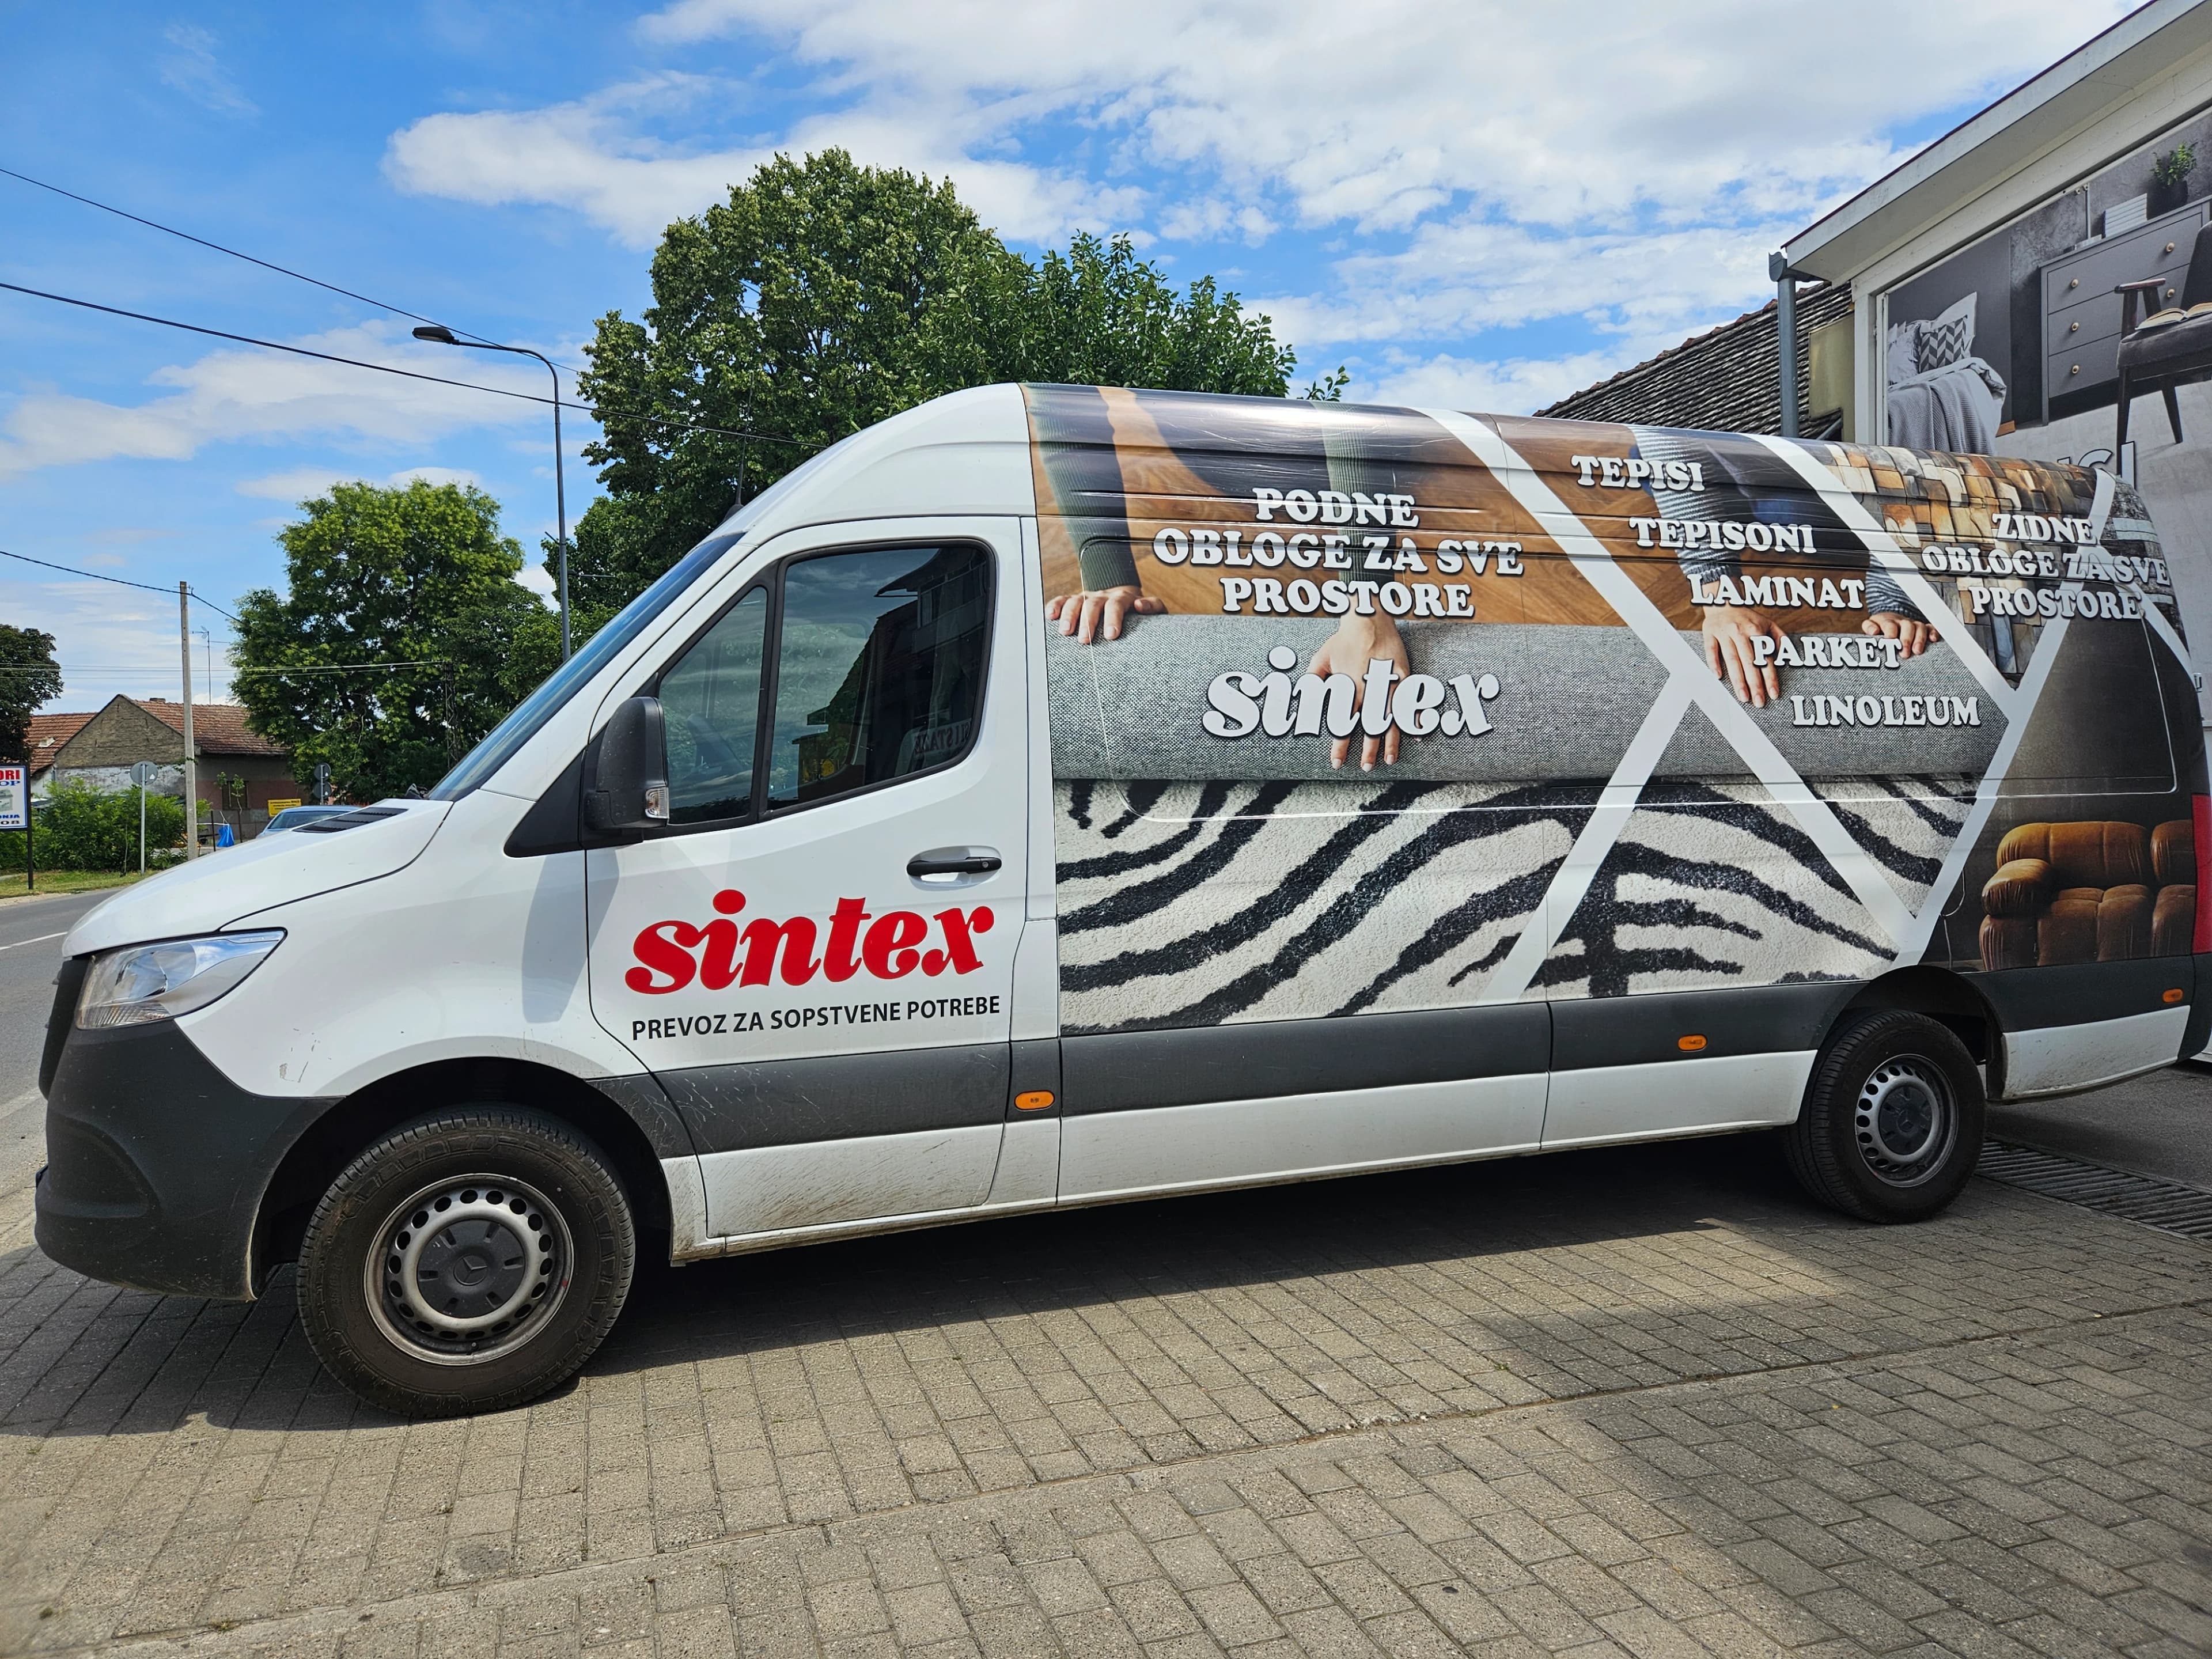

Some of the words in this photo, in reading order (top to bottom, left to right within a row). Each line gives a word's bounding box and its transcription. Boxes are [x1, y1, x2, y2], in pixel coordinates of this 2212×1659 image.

[1571, 455, 1705, 492] TEPISI
[1252, 487, 1419, 528] PODNE
[1629, 517, 1817, 554] TEPISONI
[1992, 513, 2098, 546] ZIDNE
[1153, 527, 1353, 570] OBLOGE
[1362, 535, 1427, 572] ZA
[1435, 539, 1525, 575] SVE
[1922, 546, 2060, 578] OBLOGE
[2062, 552, 2112, 582] ZA
[2112, 556, 2171, 586] SVE
[1219, 577, 1475, 618] PROSTORE
[1687, 573, 1865, 609] LAMINAT
[1968, 586, 2147, 620] PROSTORE
[1749, 635, 1902, 668] PARKET
[1202, 646, 1500, 738] sintex
[1790, 695, 1982, 726] LINOLEUM
[625, 889, 994, 994] sintex
[632, 1014, 727, 1040] PREVOZ
[733, 1012, 764, 1032] ZA
[770, 1002, 900, 1031] SOPSTVENE
[907, 995, 1000, 1020] POTREBE
